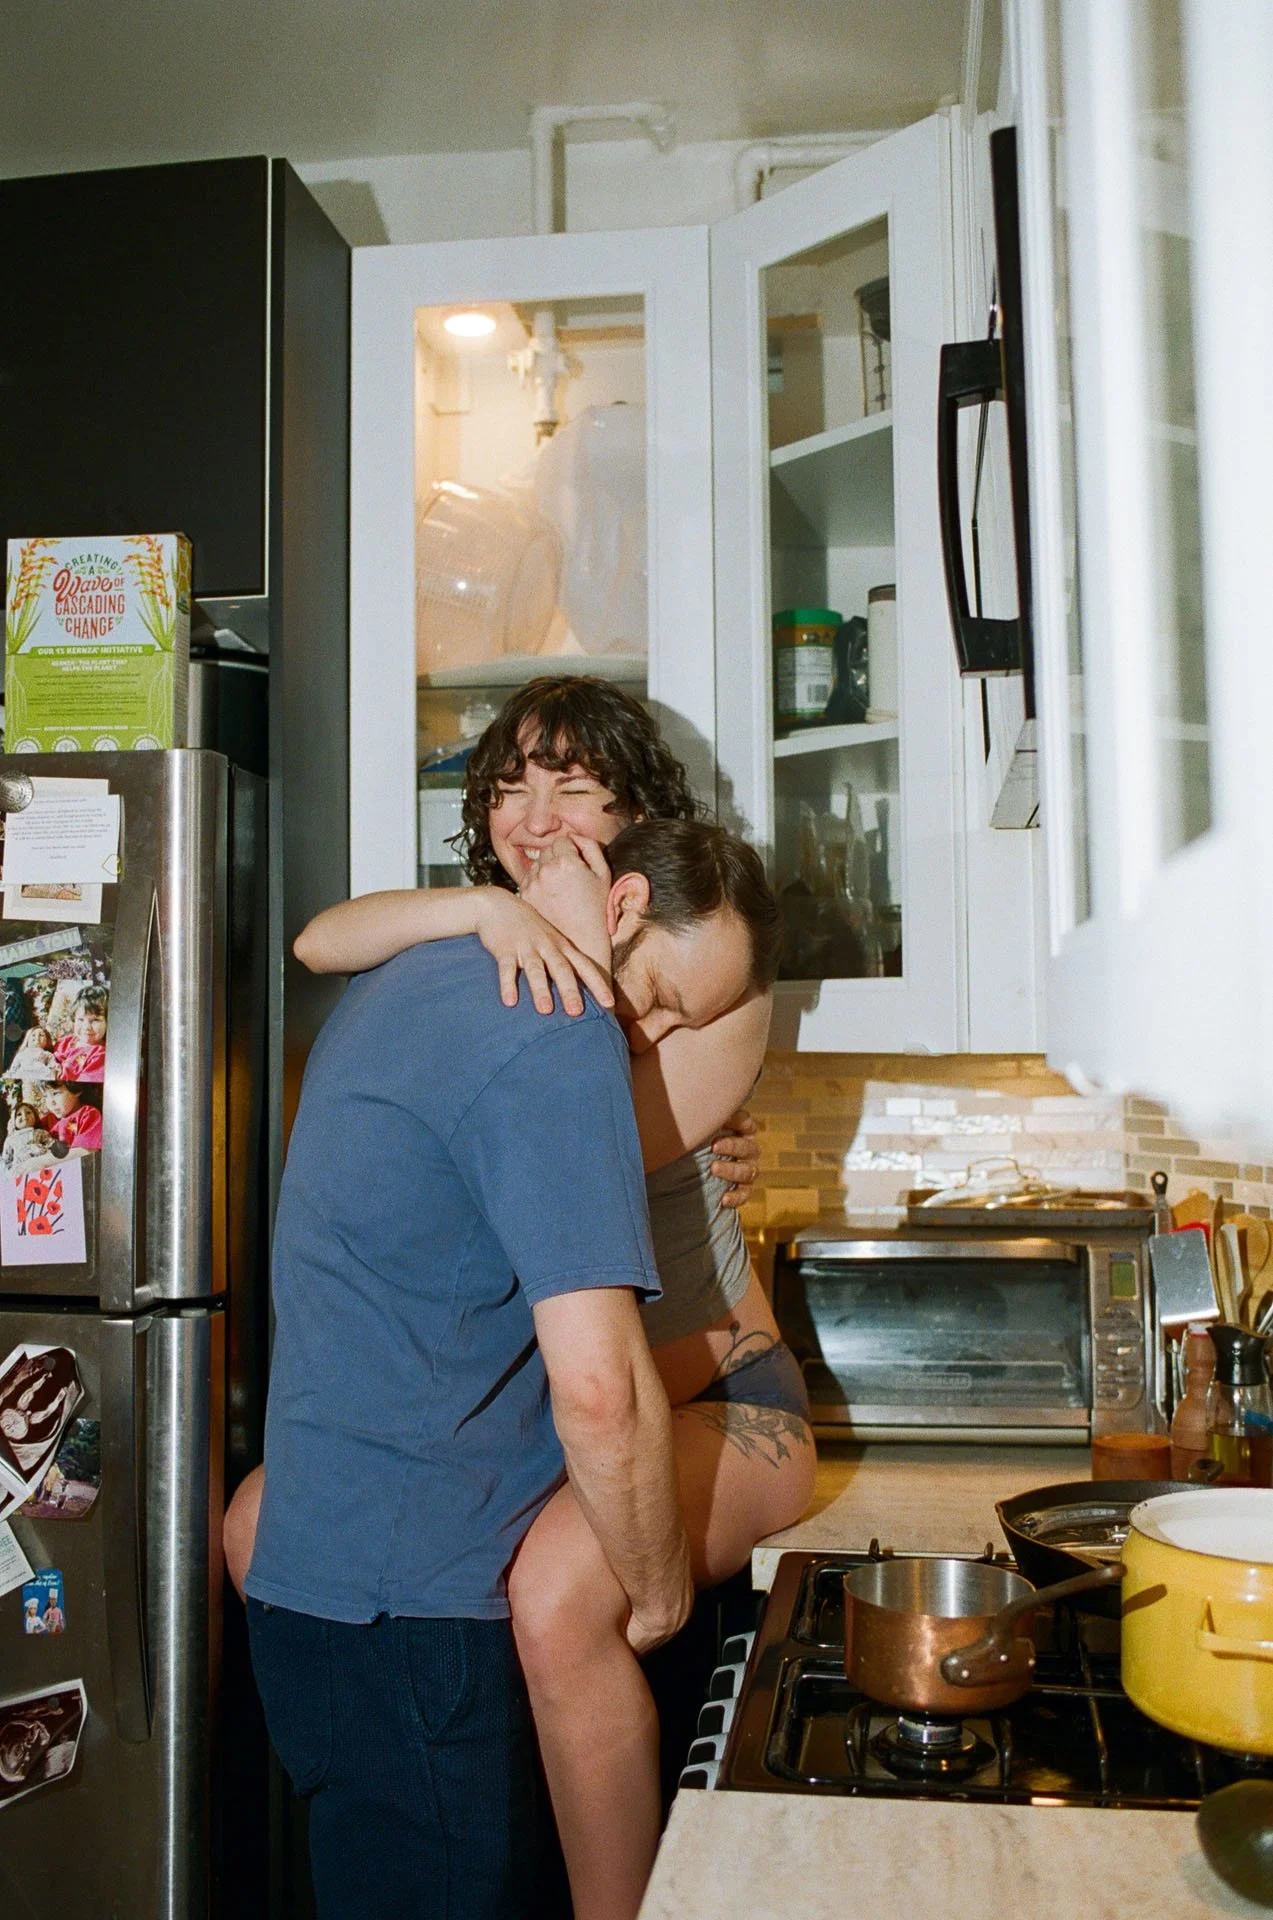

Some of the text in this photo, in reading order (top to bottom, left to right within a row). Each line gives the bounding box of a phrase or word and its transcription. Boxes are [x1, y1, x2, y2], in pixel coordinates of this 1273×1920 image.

[65, 553, 118, 570] CREATING
[88, 565, 95, 575] A
[52, 568, 125, 603] Wave OF
[55, 594, 125, 616] CASCADING
[65, 616, 114, 639] CHANGE
[38, 647, 54, 655] OUR
[100, 645, 143, 654] INITIATIVE
